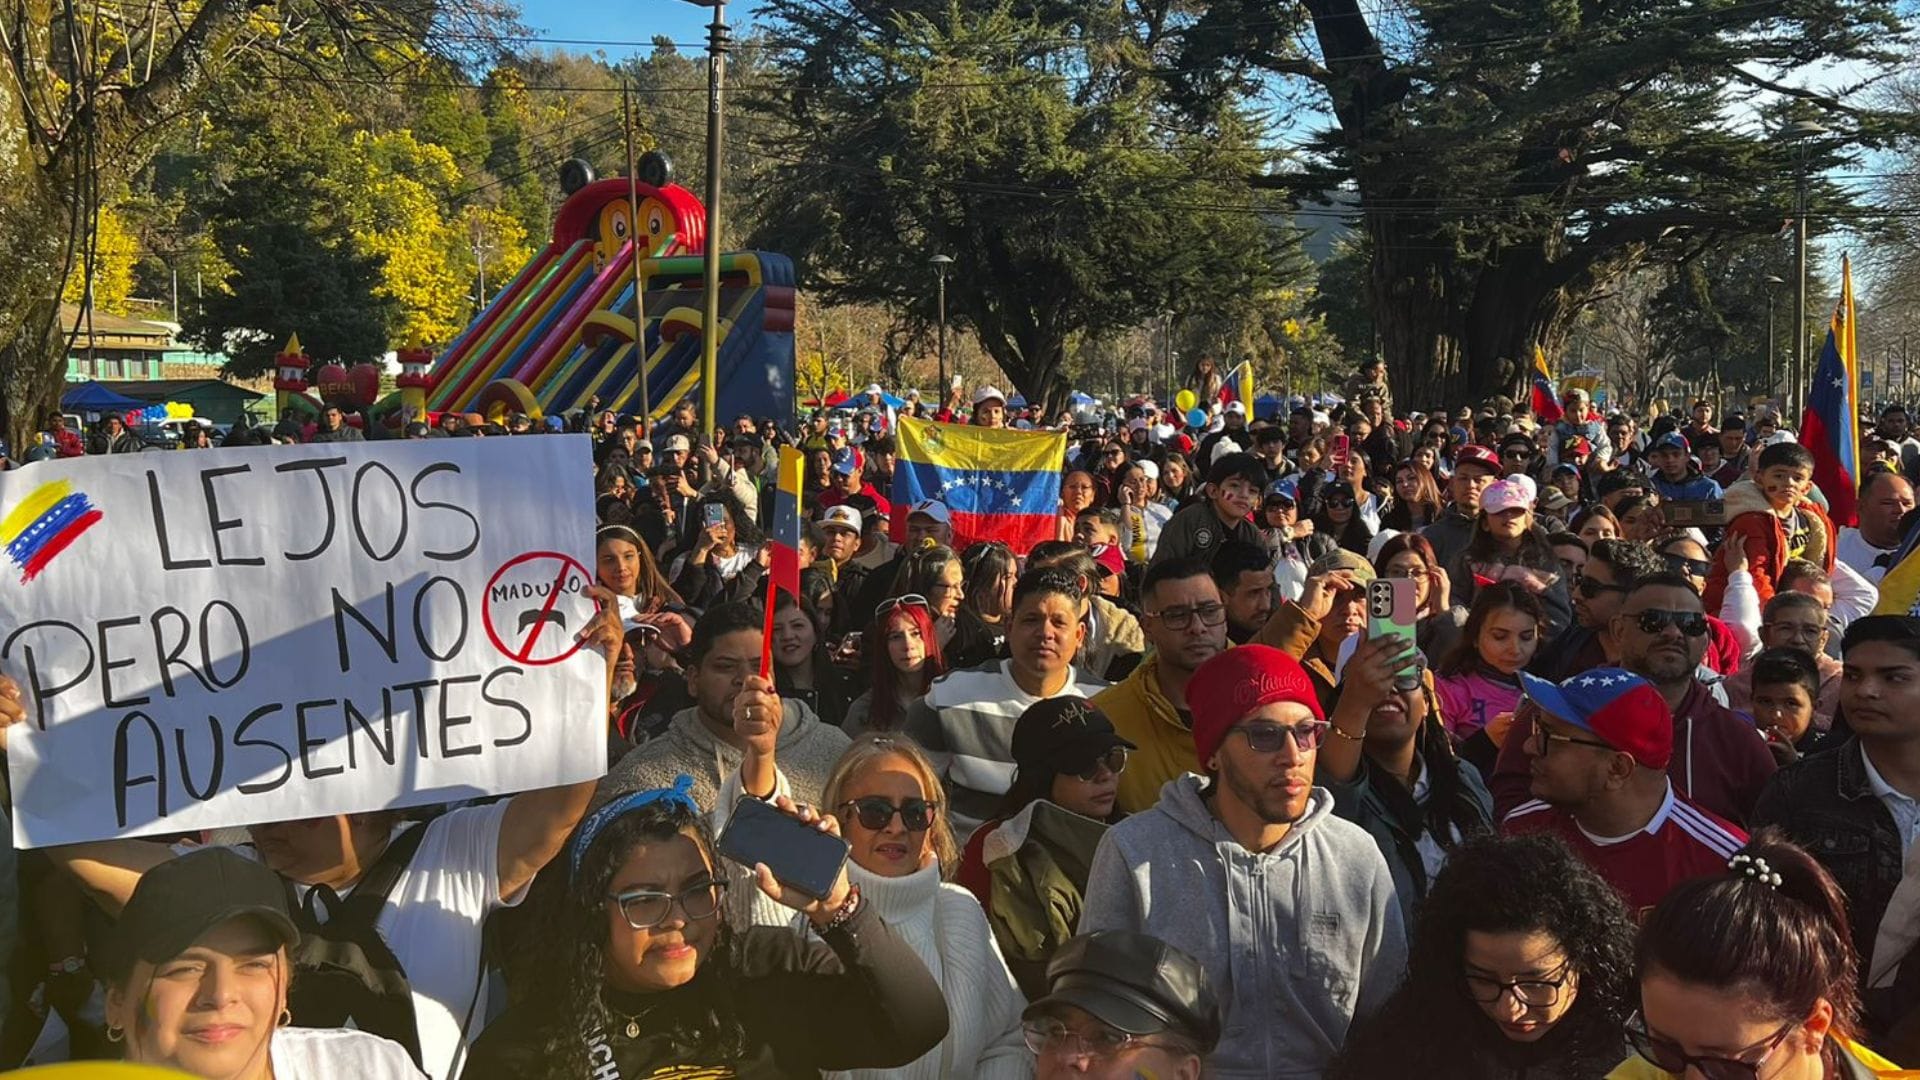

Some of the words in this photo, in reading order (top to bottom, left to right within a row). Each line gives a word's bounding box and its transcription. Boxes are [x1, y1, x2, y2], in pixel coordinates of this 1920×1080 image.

[146, 457, 480, 570] LEJOS
[2, 600, 250, 731] PERO
[331, 576, 469, 672] NO
[492, 575, 581, 603] MADURO
[114, 666, 531, 828] AUSENTES
